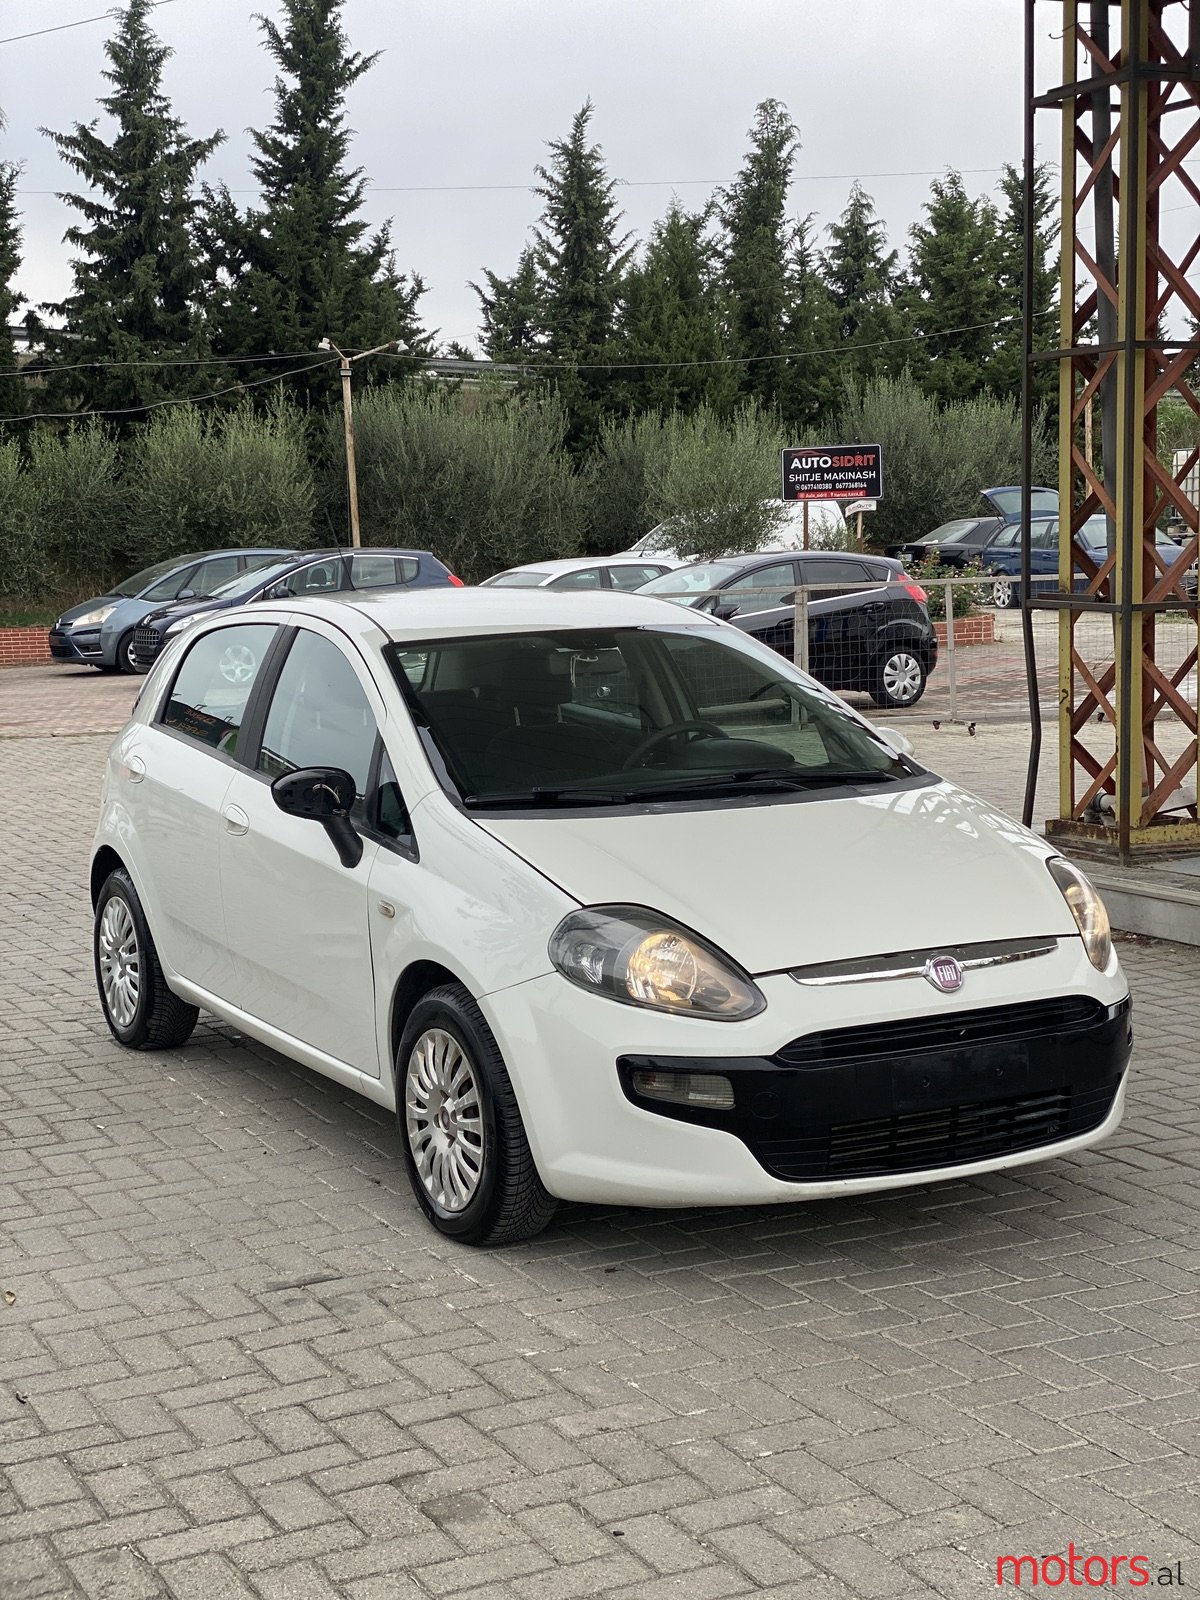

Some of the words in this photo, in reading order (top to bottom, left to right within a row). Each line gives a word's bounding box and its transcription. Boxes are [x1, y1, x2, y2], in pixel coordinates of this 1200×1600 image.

[789, 473, 822, 482] SHITJE
[824, 470, 876, 481] MAKINASH
[937, 964, 957, 982] FIAT
